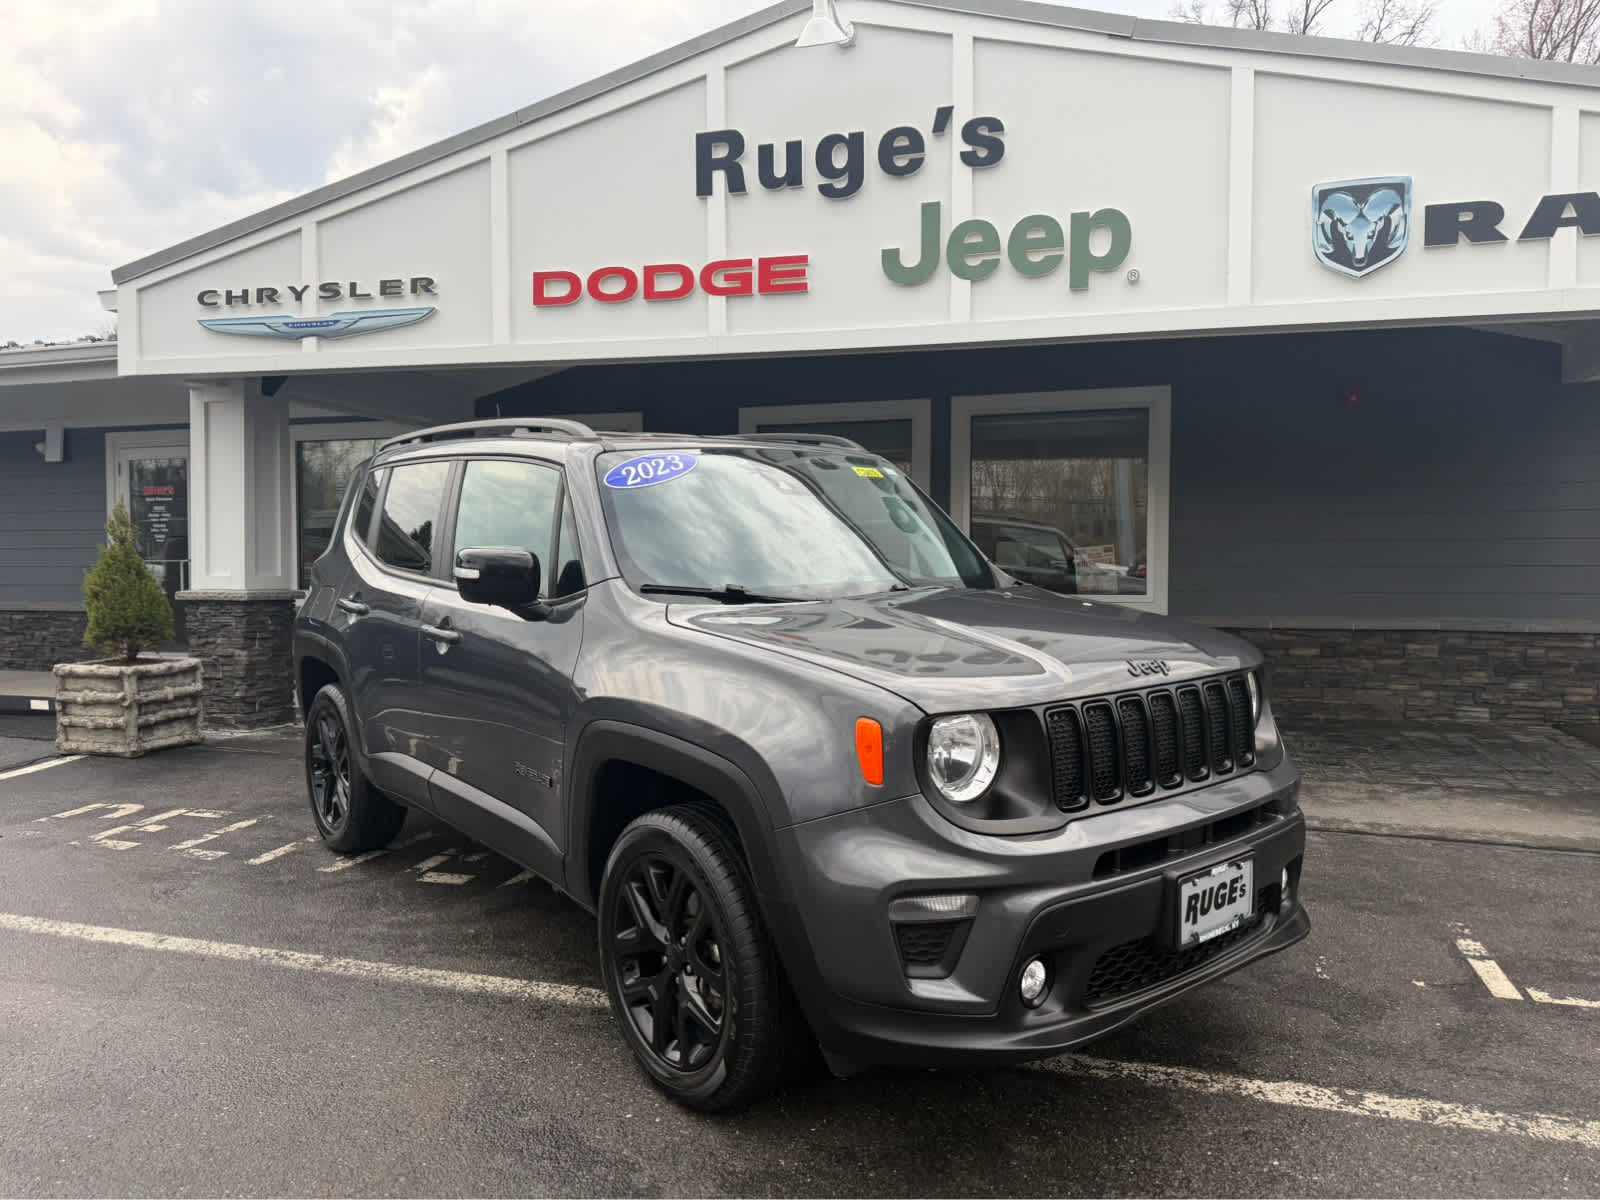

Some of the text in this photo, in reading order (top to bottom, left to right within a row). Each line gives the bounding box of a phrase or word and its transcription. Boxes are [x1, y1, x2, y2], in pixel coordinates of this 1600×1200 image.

[696, 105, 1005, 200] Ruge's
[881, 201, 1132, 290] Jeep
[1425, 192, 1600, 248] RA
[197, 276, 438, 307] CHRYSLER
[532, 254, 809, 307] DODGE
[621, 454, 685, 486] 2023
[1125, 657, 1171, 678] Jeep
